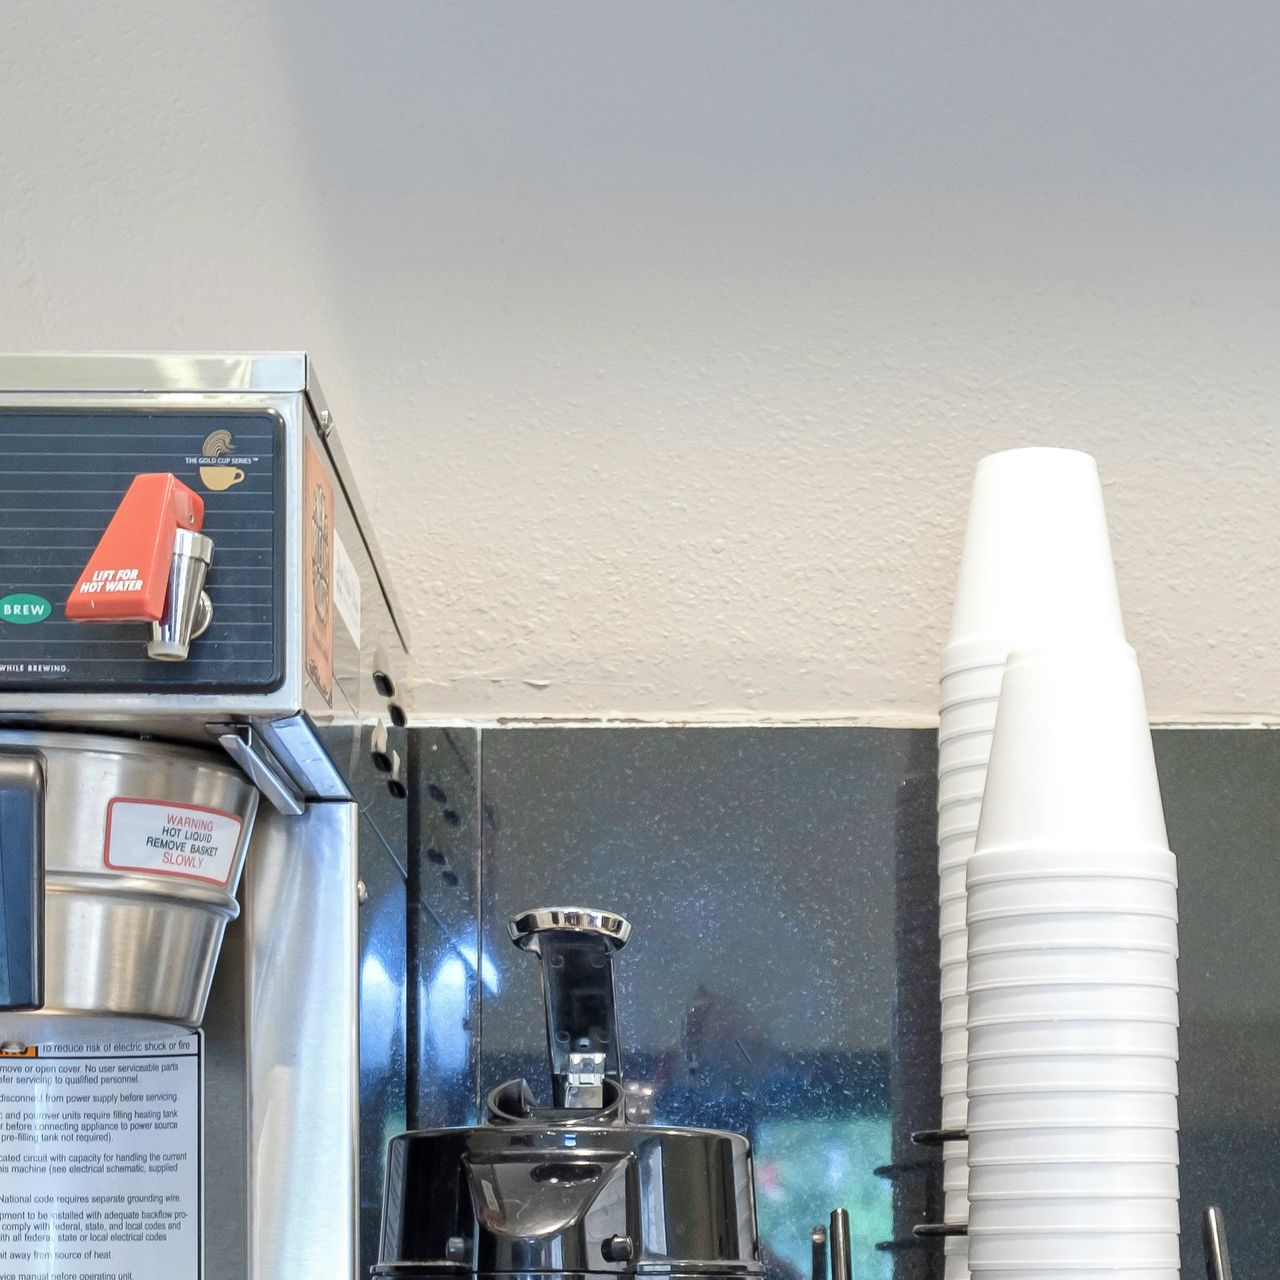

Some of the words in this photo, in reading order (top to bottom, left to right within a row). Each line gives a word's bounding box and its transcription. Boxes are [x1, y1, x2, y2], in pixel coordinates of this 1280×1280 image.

[93, 570, 114, 581] LIFT
[116, 569, 139, 580] FOR
[80, 582, 103, 593] HOT
[106, 580, 143, 592] WATER
[3, 604, 45, 615] BREW
[0, 664, 24, 672] WHILE
[27, 664, 70, 672] BREWING.
[167, 813, 214, 832] WARNING
[161, 826, 182, 838] HOT
[184, 831, 212, 843] LIQUID
[146, 837, 186, 853] REMOVE
[190, 843, 218, 857] BASKET
[162, 852, 204, 869] SLOWLY
[113, 1042, 142, 1051] electric
[144, 1041, 166, 1050] shock
[178, 1040, 190, 1050] fire
[35, 1067, 56, 1076] open
[118, 1063, 159, 1072] serviceable
[161, 1063, 179, 1073] parts
[16, 1076, 52, 1086] servicing
[55, 1076, 62, 1084] to
[65, 1075, 98, 1085] qualified
[45, 1094, 63, 1102] from
[66, 1095, 90, 1104] power
[93, 1094, 118, 1104] supply
[120, 1093, 144, 1101] before
[6, 1111, 20, 1119] and
[62, 1111, 81, 1120] units
[83, 1112, 111, 1120] require
[113, 1110, 132, 1121] filling
[134, 1110, 161, 1120] heating
[163, 1109, 178, 1118] tank
[6, 1122, 32, 1130] before
[34, 1122, 78, 1132] connecting
[81, 1122, 118, 1131] appliance
[121, 1122, 128, 1130] to
[130, 1123, 152, 1132] power
[1, 1133, 39, 1144] pre-filling
[41, 1133, 58, 1142] tank
[61, 1133, 74, 1141] not
[23, 1154, 47, 1162] circuit
[50, 1153, 67, 1162] with
[69, 1154, 101, 1164] capacity
[103, 1153, 114, 1162] for
[116, 1153, 147, 1163] handling
[149, 1152, 160, 1161] the
[163, 1152, 187, 1161] current
[11, 1165, 46, 1173] machine
[49, 1165, 67, 1174] (see
[69, 1164, 104, 1173] electrical
[106, 1165, 146, 1173] schematic,
[149, 1164, 178, 1173] supplied
[34, 1195, 54, 1203] code
[56, 1194, 88, 1204] requires
[91, 1195, 125, 1204] separate
[127, 1194, 163, 1204] grounding
[28, 1211, 35, 1219] to
[38, 1211, 47, 1219] be
[86, 1211, 101, 1219] with
[104, 1211, 139, 1222] adequate
[141, 1210, 172, 1219] backflow
[174, 1211, 188, 1220] pro-
[2, 1222, 31, 1233] comply
[34, 1222, 50, 1230] with
[109, 1222, 123, 1230] and
[125, 1222, 142, 1230] local
[145, 1222, 166, 1230] codes
[168, 1221, 181, 1230] and
[13, 1233, 22, 1241] all
[58, 1233, 78, 1242] state
[90, 1233, 108, 1241] local
[110, 1233, 143, 1241] electrical
[145, 1233, 167, 1241] codes
[10, 1253, 31, 1262] away
[84, 1250, 92, 1259] of
[18, 1273, 48, 1280] manual
